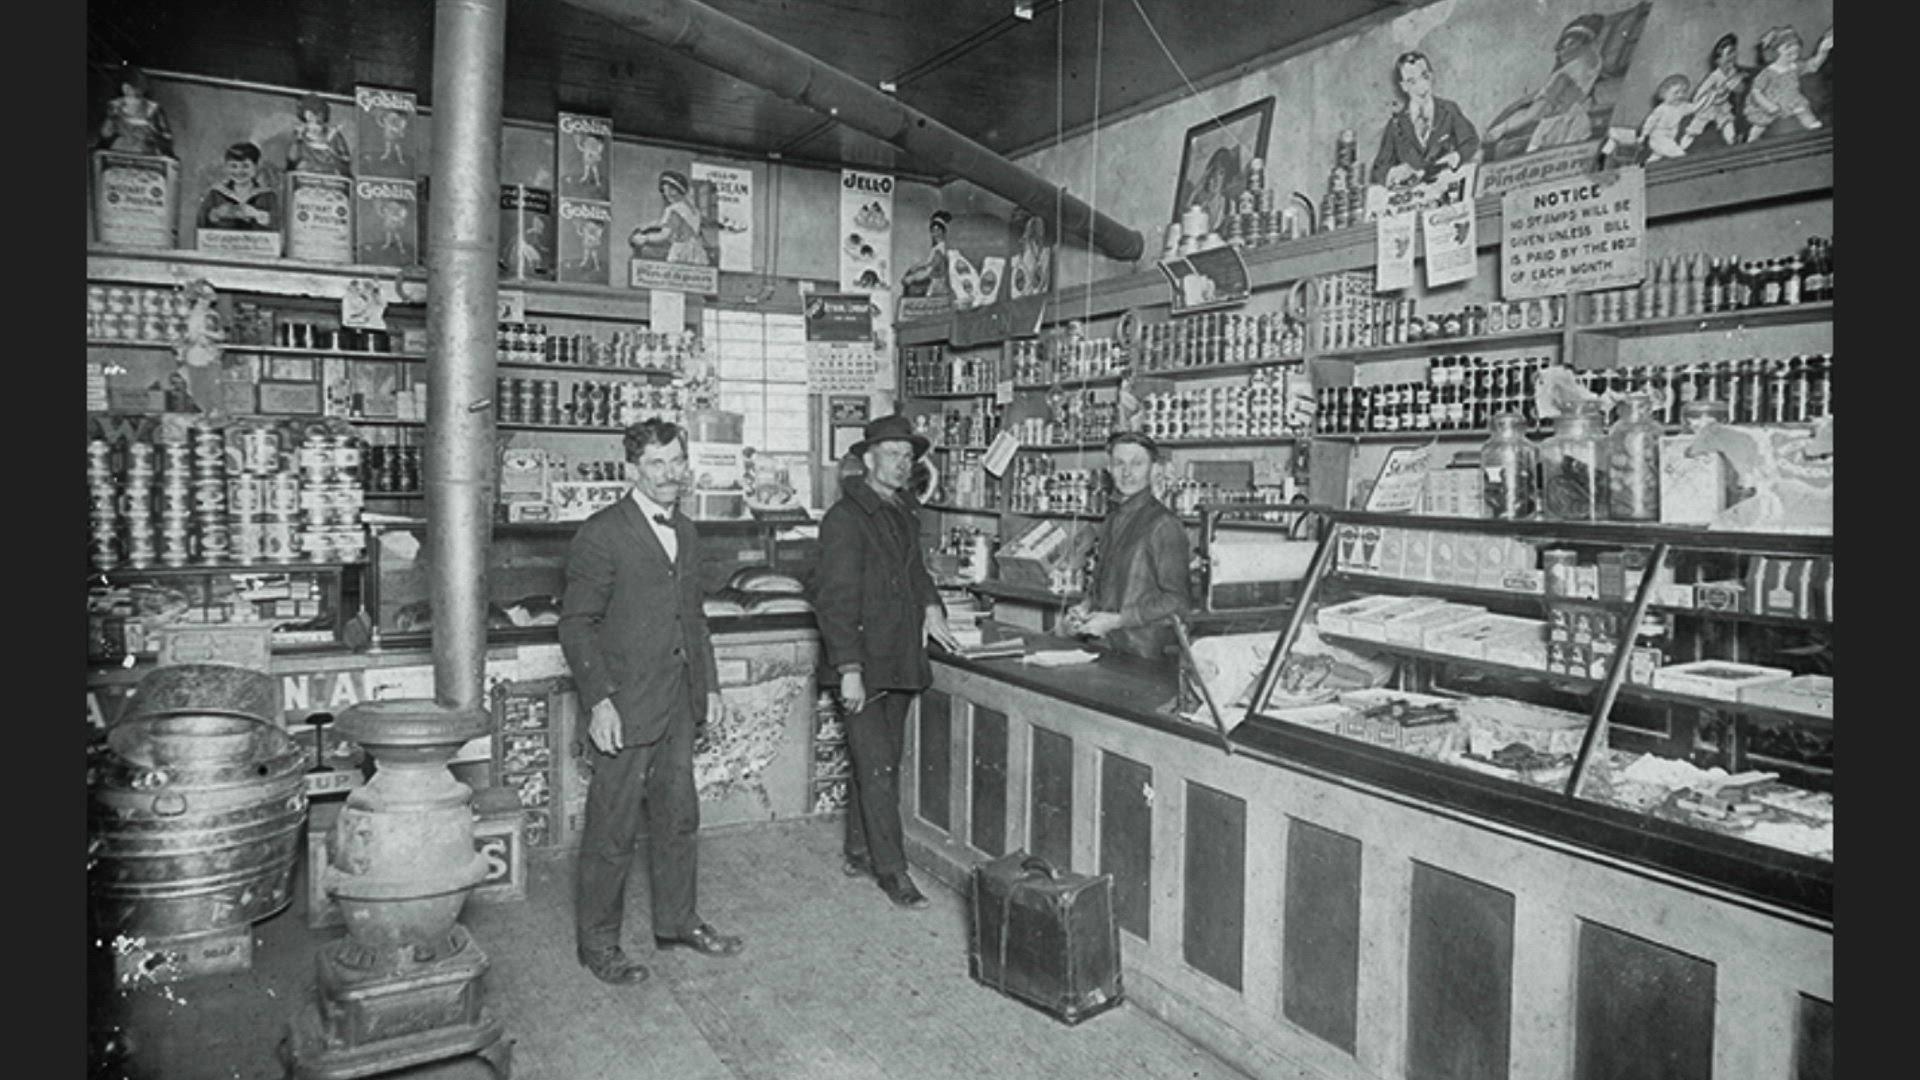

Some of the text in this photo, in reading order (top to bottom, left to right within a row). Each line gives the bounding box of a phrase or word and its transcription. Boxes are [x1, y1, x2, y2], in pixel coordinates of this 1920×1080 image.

[559, 117, 612, 136] Goblin
[1534, 183, 1600, 209] NOTICE
[1527, 209, 1577, 229] STAMPS
[1582, 203, 1609, 218] WILL
[1614, 199, 1630, 213] BE
[1510, 219, 1630, 248] GIVEN UNLESS BILL
[1510, 254, 1522, 266] IS
[1526, 248, 1556, 263] PAID
[1561, 246, 1578, 260] BY
[1583, 240, 1608, 254] THE
[1510, 270, 1525, 284] OF
[1531, 266, 1566, 281] EACH
[1570, 260, 1612, 275] MONTH
